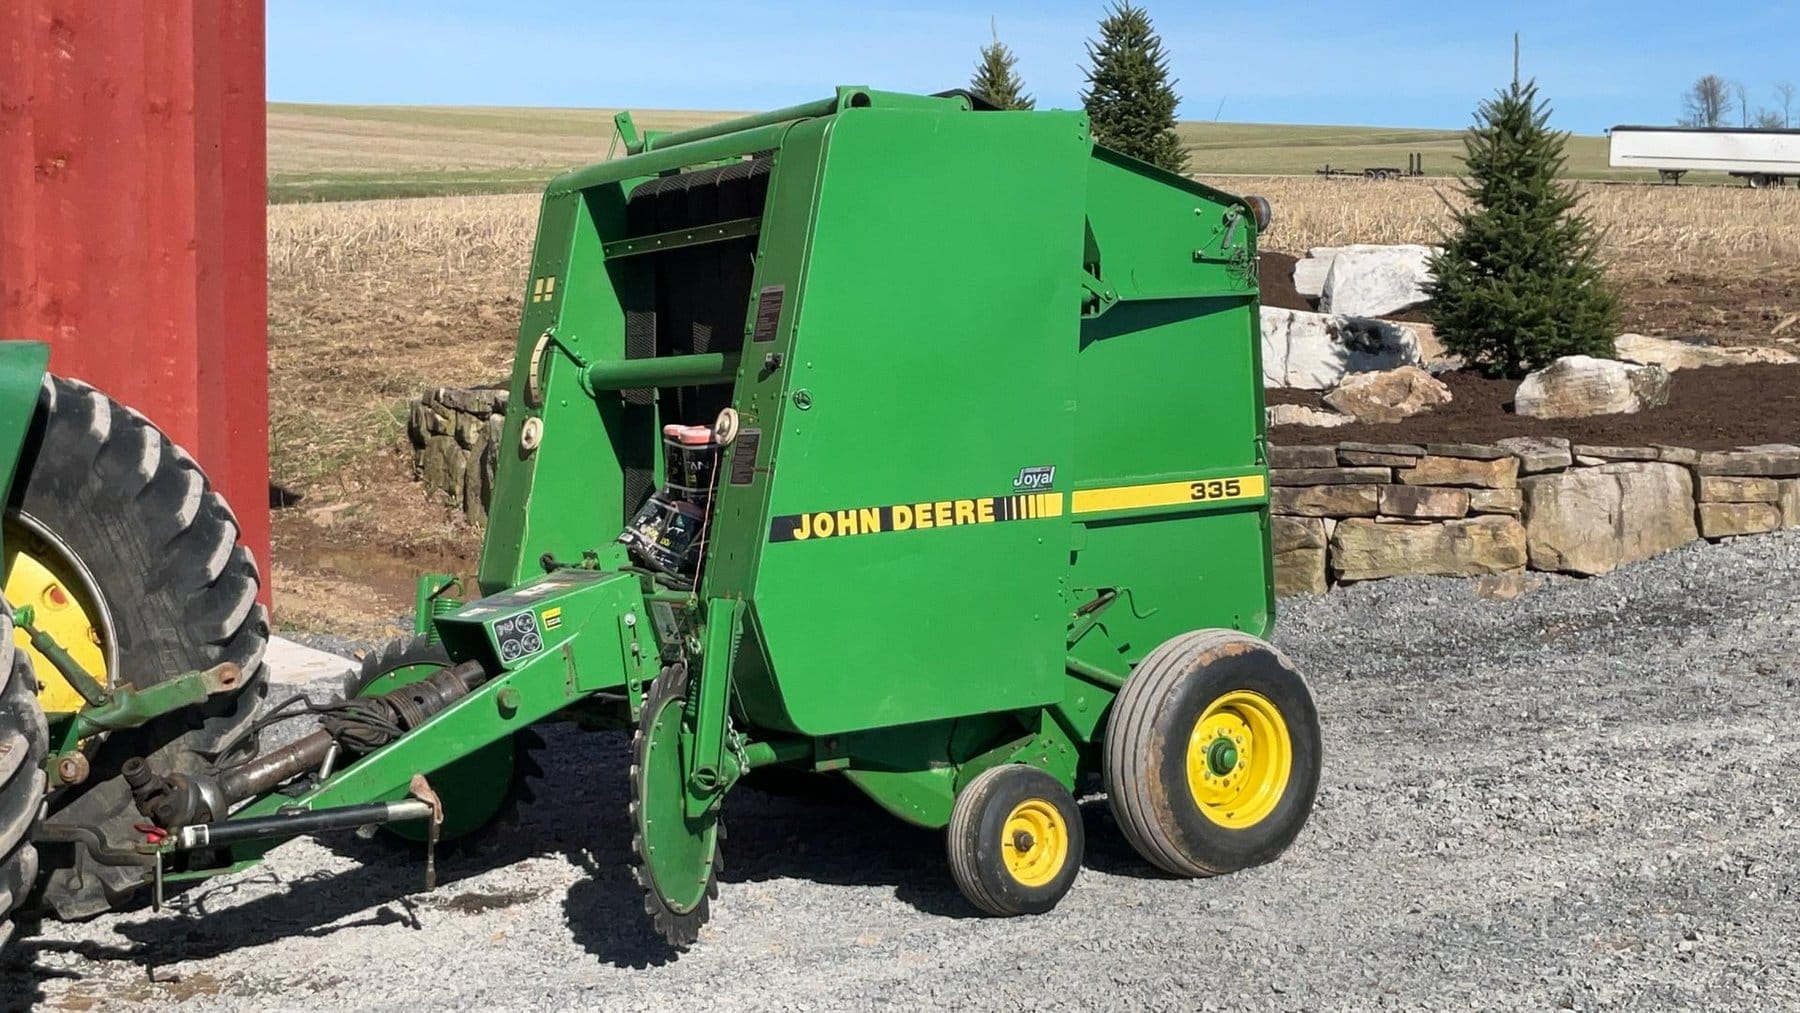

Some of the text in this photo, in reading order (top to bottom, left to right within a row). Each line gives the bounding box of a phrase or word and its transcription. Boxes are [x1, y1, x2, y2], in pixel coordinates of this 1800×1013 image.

[1013, 466, 1056, 488] Joyal
[1190, 479, 1241, 500] 335
[793, 498, 995, 540] JOHN DEERE
